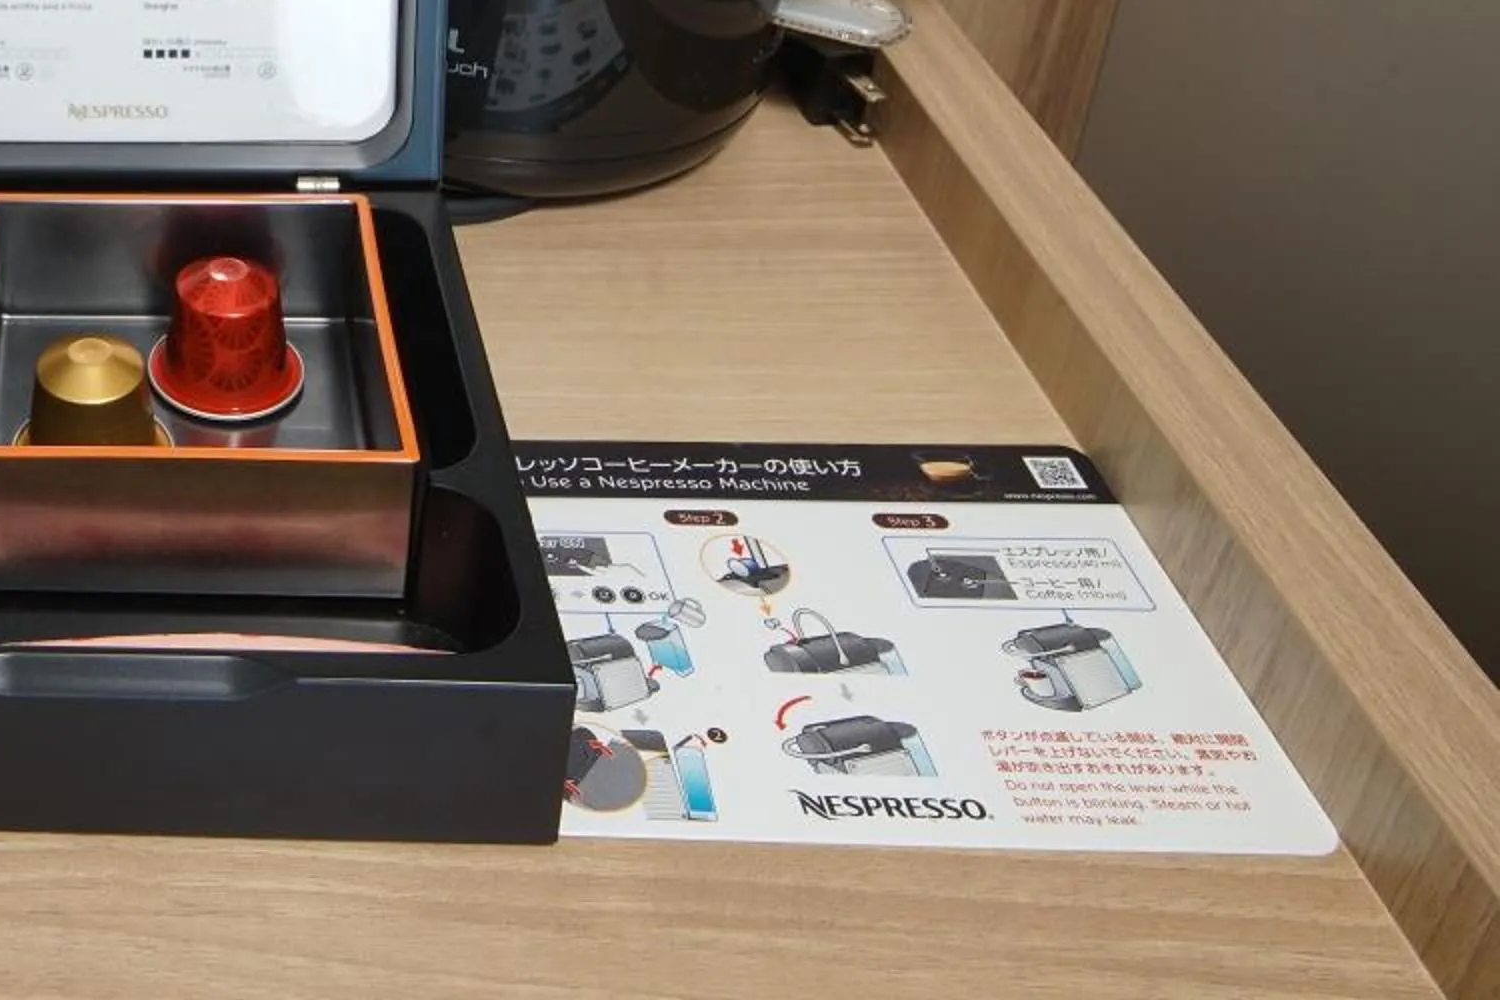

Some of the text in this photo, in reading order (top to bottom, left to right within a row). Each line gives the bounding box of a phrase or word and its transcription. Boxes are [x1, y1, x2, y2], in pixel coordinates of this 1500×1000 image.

[67, 103, 169, 121] NESPRESSO
[515, 455, 862, 477] レッソコーヒーメーカーの使い方
[530, 474, 572, 488] Use
[579, 476, 592, 488] a
[598, 475, 713, 492] Nespresso
[719, 475, 811, 492] Machine
[677, 512, 726, 525] Step 2
[886, 515, 937, 528] Step 3
[789, 789, 988, 821] NESPRESSO
